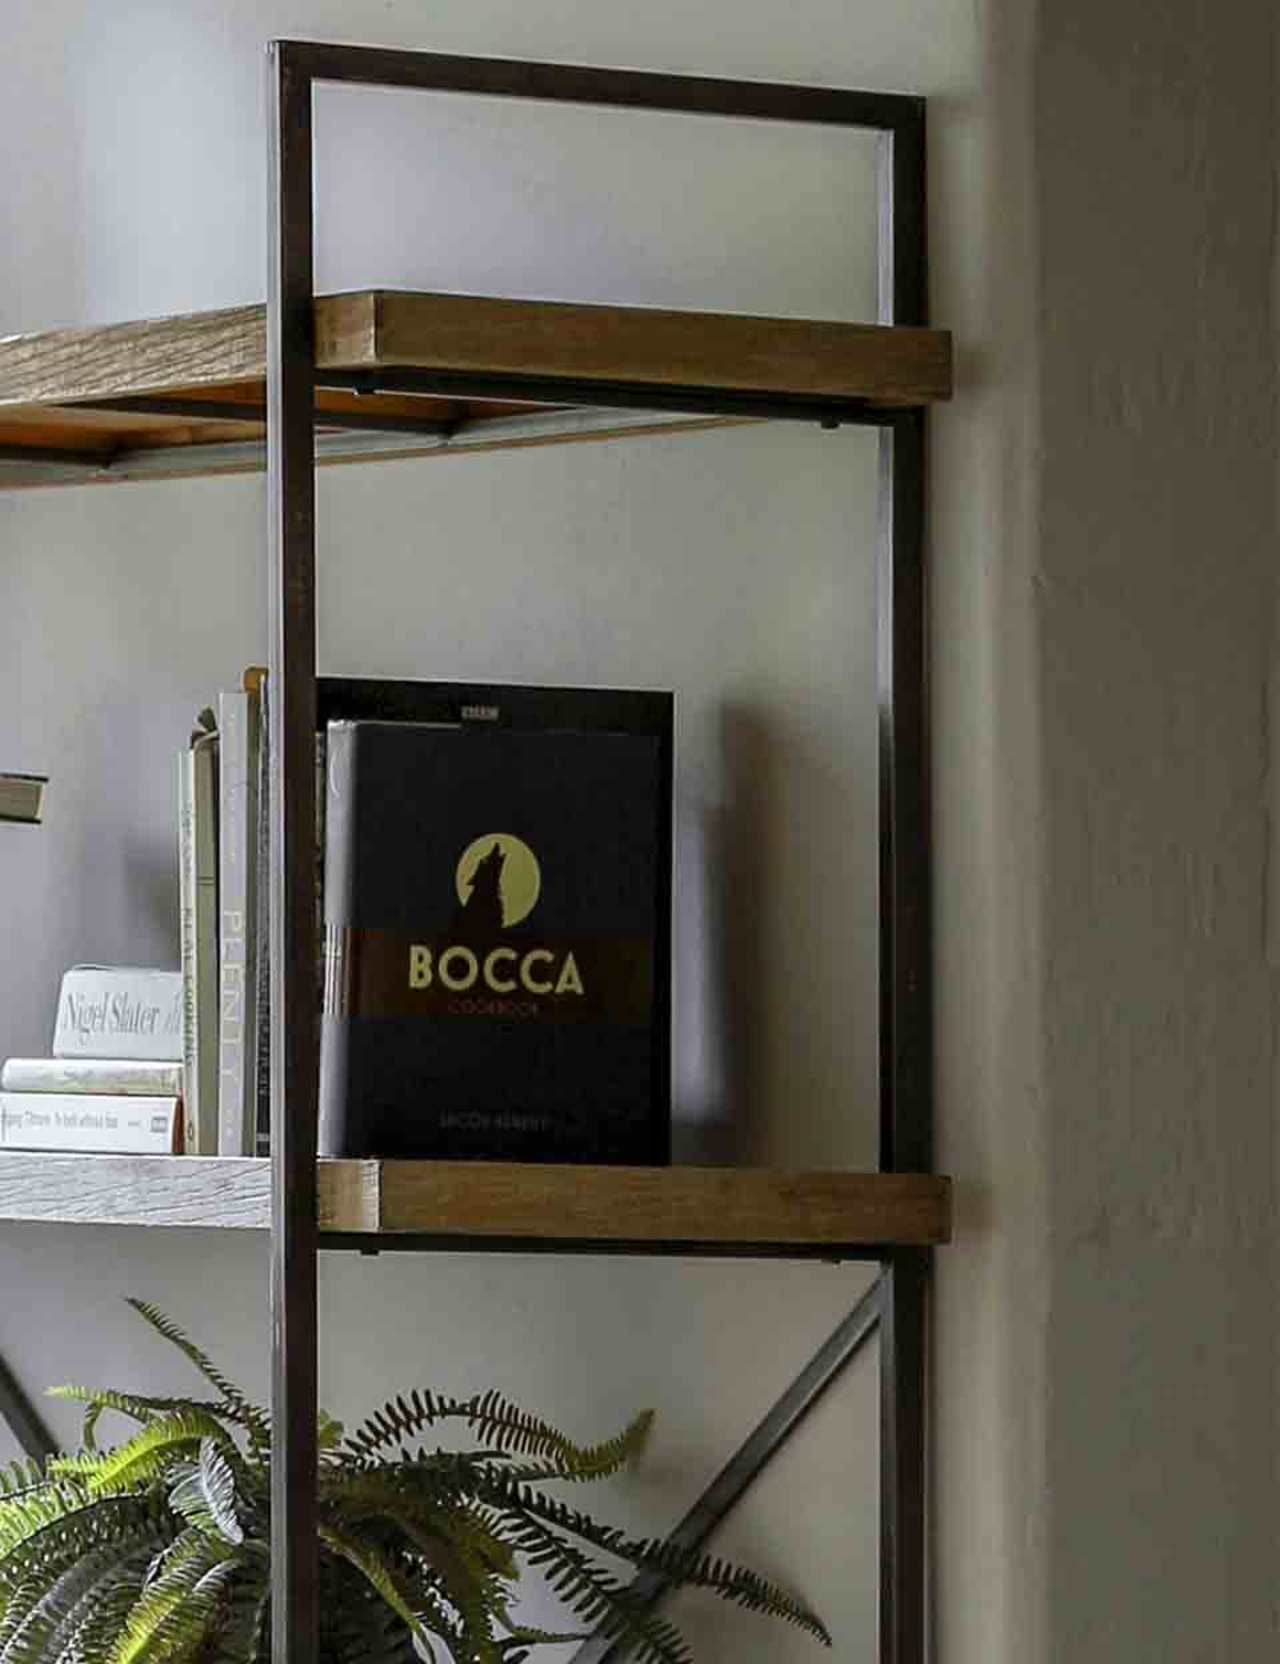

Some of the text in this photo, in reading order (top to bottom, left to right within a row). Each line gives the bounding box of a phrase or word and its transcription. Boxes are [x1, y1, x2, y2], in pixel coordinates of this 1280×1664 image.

[409, 945, 584, 994] BOCCA
[63, 991, 109, 1045] Nigel
[111, 991, 160, 1035] Slater
[222, 910, 243, 1084] PLENTY
